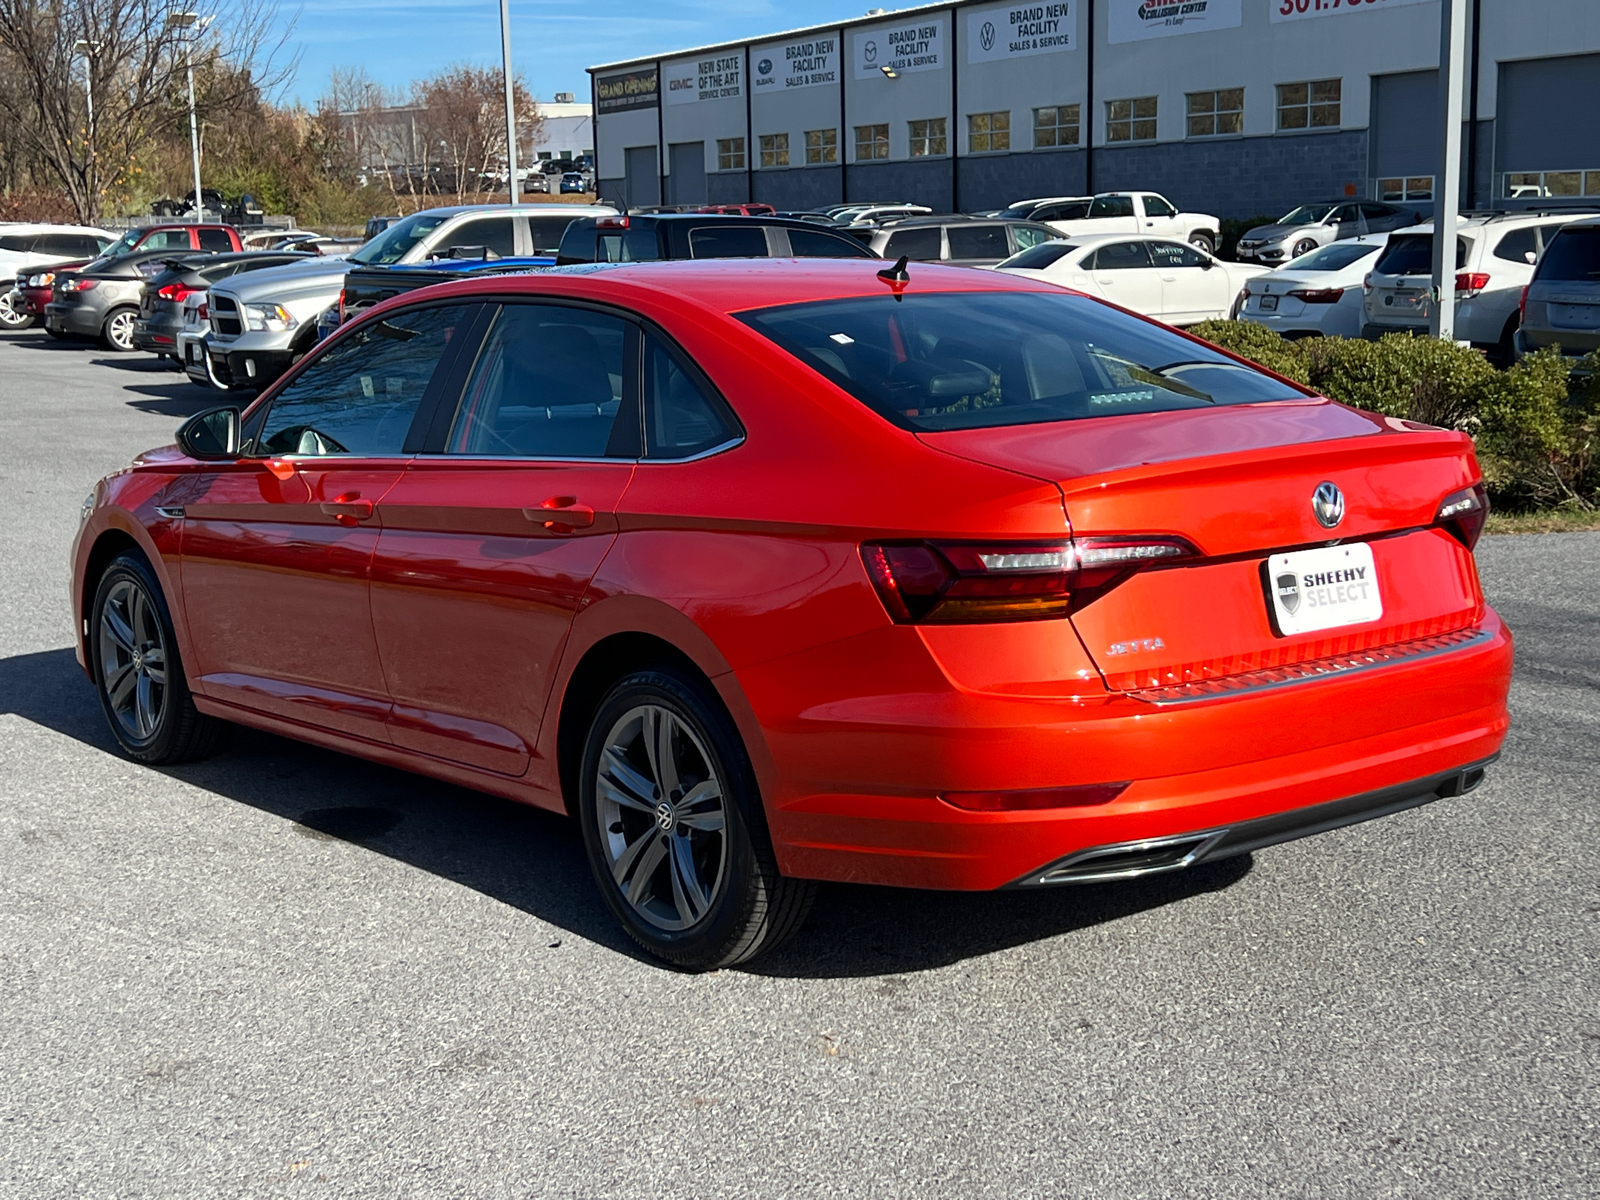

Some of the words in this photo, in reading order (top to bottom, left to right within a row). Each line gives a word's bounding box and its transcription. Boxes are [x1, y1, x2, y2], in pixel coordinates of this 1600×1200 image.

[1010, 7, 1043, 24] BRAND
[1046, 3, 1068, 18] NEW
[1145, 5, 1180, 20] COLLISION
[1180, 1, 1207, 15] CENTER
[889, 29, 916, 45] BRAND
[918, 26, 937, 40] NEW
[1018, 19, 1059, 38] FACILITY
[786, 43, 813, 60] BRAND
[815, 40, 834, 55] NEW
[895, 40, 929, 57] FACILITY
[1009, 40, 1030, 52] SALES
[1032, 39, 1038, 49] &
[1039, 34, 1069, 48] SERVICE
[698, 60, 715, 75] NEW
[716, 56, 739, 72] STATE
[793, 56, 827, 73] FACILITY
[888, 58, 906, 69] SALES
[907, 58, 912, 67] &
[913, 54, 937, 66] SERVICE
[599, 82, 624, 98] GRAND
[624, 77, 657, 94] OPENING
[669, 78, 693, 91] GMC
[698, 76, 708, 89] OF
[708, 74, 723, 88] THE
[724, 72, 739, 86] ART
[785, 75, 803, 87] SALES
[804, 75, 809, 85] &
[810, 71, 835, 84] SERVICE
[698, 89, 719, 100] SERVICE
[720, 86, 740, 98] CENTER
[1303, 566, 1366, 588] SHEEHY
[1306, 582, 1369, 608] SELECT
[1105, 637, 1164, 656] JETTA
